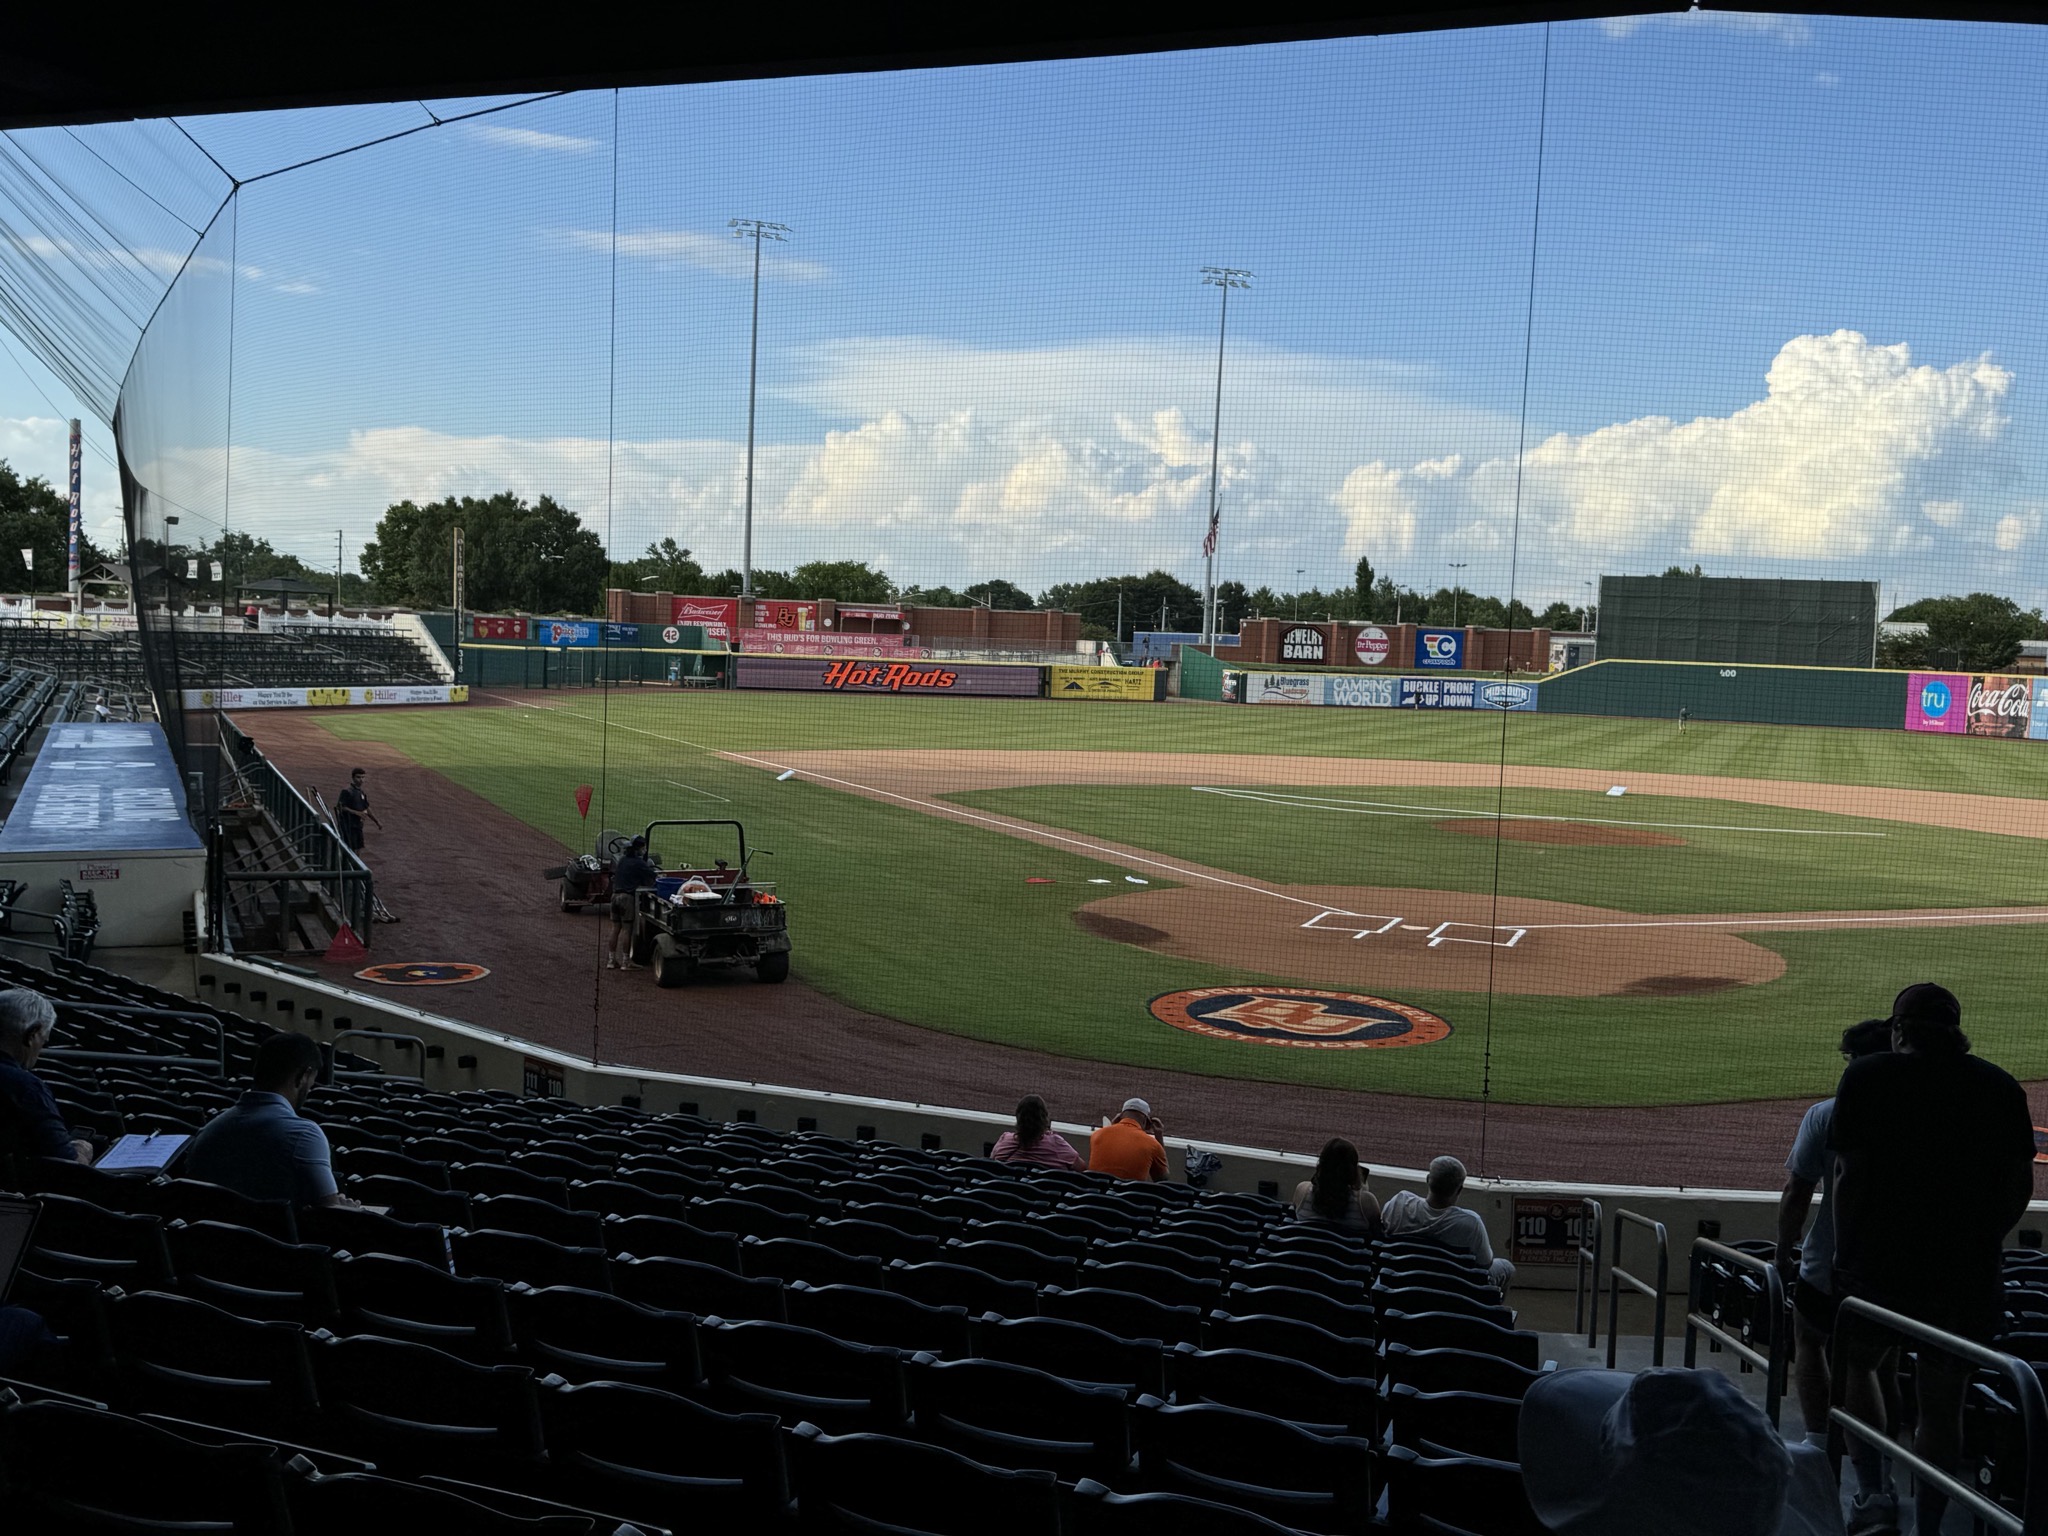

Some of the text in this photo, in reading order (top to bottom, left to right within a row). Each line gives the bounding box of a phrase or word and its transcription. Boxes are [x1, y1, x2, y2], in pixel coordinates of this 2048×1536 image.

[664, 631, 677, 641] 42
[767, 632, 782, 641] THIS
[784, 633, 805, 642] BUD'S
[806, 635, 821, 643] FOR
[821, 635, 853, 645] BOWLING
[854, 637, 878, 645] GREEN.
[1283, 628, 1322, 645] JEWELRY
[1366, 639, 1389, 651] Pepper
[1283, 645, 1323, 660] BARN
[824, 661, 957, 691] Hot Rods
[1720, 669, 1737, 678] 400
[1281, 676, 1309, 688] Bluegrass
[1333, 678, 1393, 694] CAMPING
[1402, 681, 1440, 694] BUCKLE
[1444, 681, 1475, 695] PHONE
[374, 689, 396, 700] Hiller
[1333, 690, 1392, 707] WORLD
[1485, 685, 1528, 700] MID-SOUTH
[1922, 689, 1946, 708] tru
[1425, 694, 1440, 706] UP
[1443, 694, 1473, 707] DOWN
[547, 1079, 563, 1098] 110
[1517, 1204, 1549, 1213] SECTION
[1517, 1216, 1547, 1237] 110
